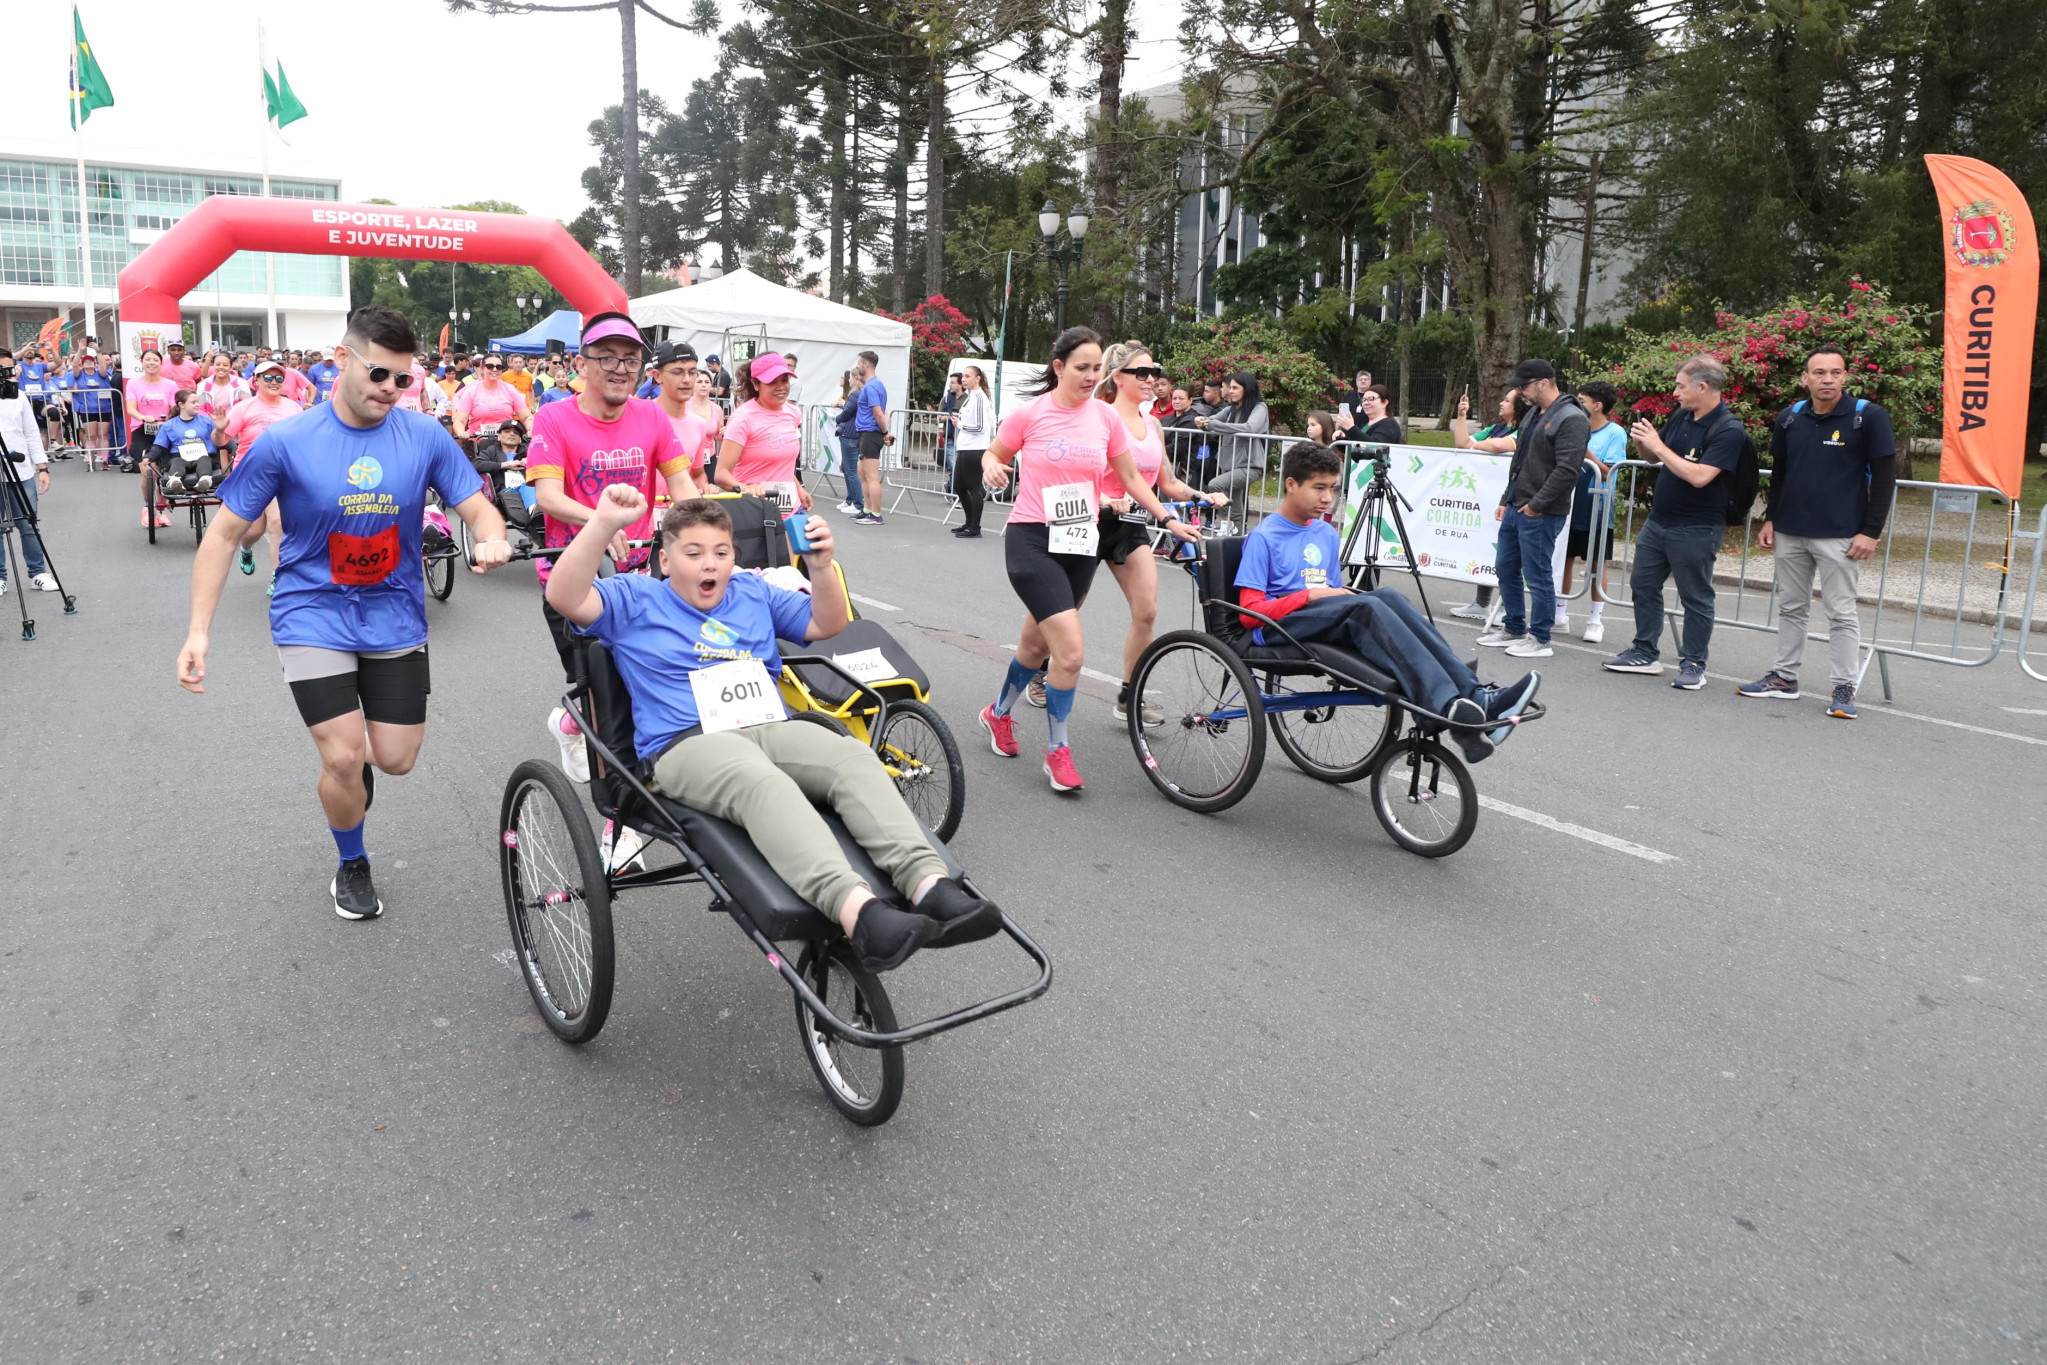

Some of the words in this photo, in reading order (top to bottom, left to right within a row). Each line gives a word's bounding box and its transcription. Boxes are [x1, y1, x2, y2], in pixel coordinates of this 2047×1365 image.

[312, 209, 410, 231] ESPORTE,
[415, 216, 478, 233] LAZER
[328, 230, 341, 244] E
[346, 231, 464, 251] JUVENTUDE
[1958, 284, 1996, 432] CURITIBA
[338, 493, 376, 506] CORRIDA
[378, 494, 393, 504] DA
[1055, 499, 1088, 519] GUIA
[1430, 497, 1481, 511] CURITIBA
[343, 504, 400, 516] ASSEMBLEIA
[1426, 508, 1481, 528] CORRIDA
[1066, 526, 1088, 539] 472
[1435, 528, 1447, 536] DE
[1450, 530, 1468, 539] RUA
[345, 548, 389, 567] 4692
[848, 662, 879, 673] 6024
[721, 681, 763, 703] 6011
